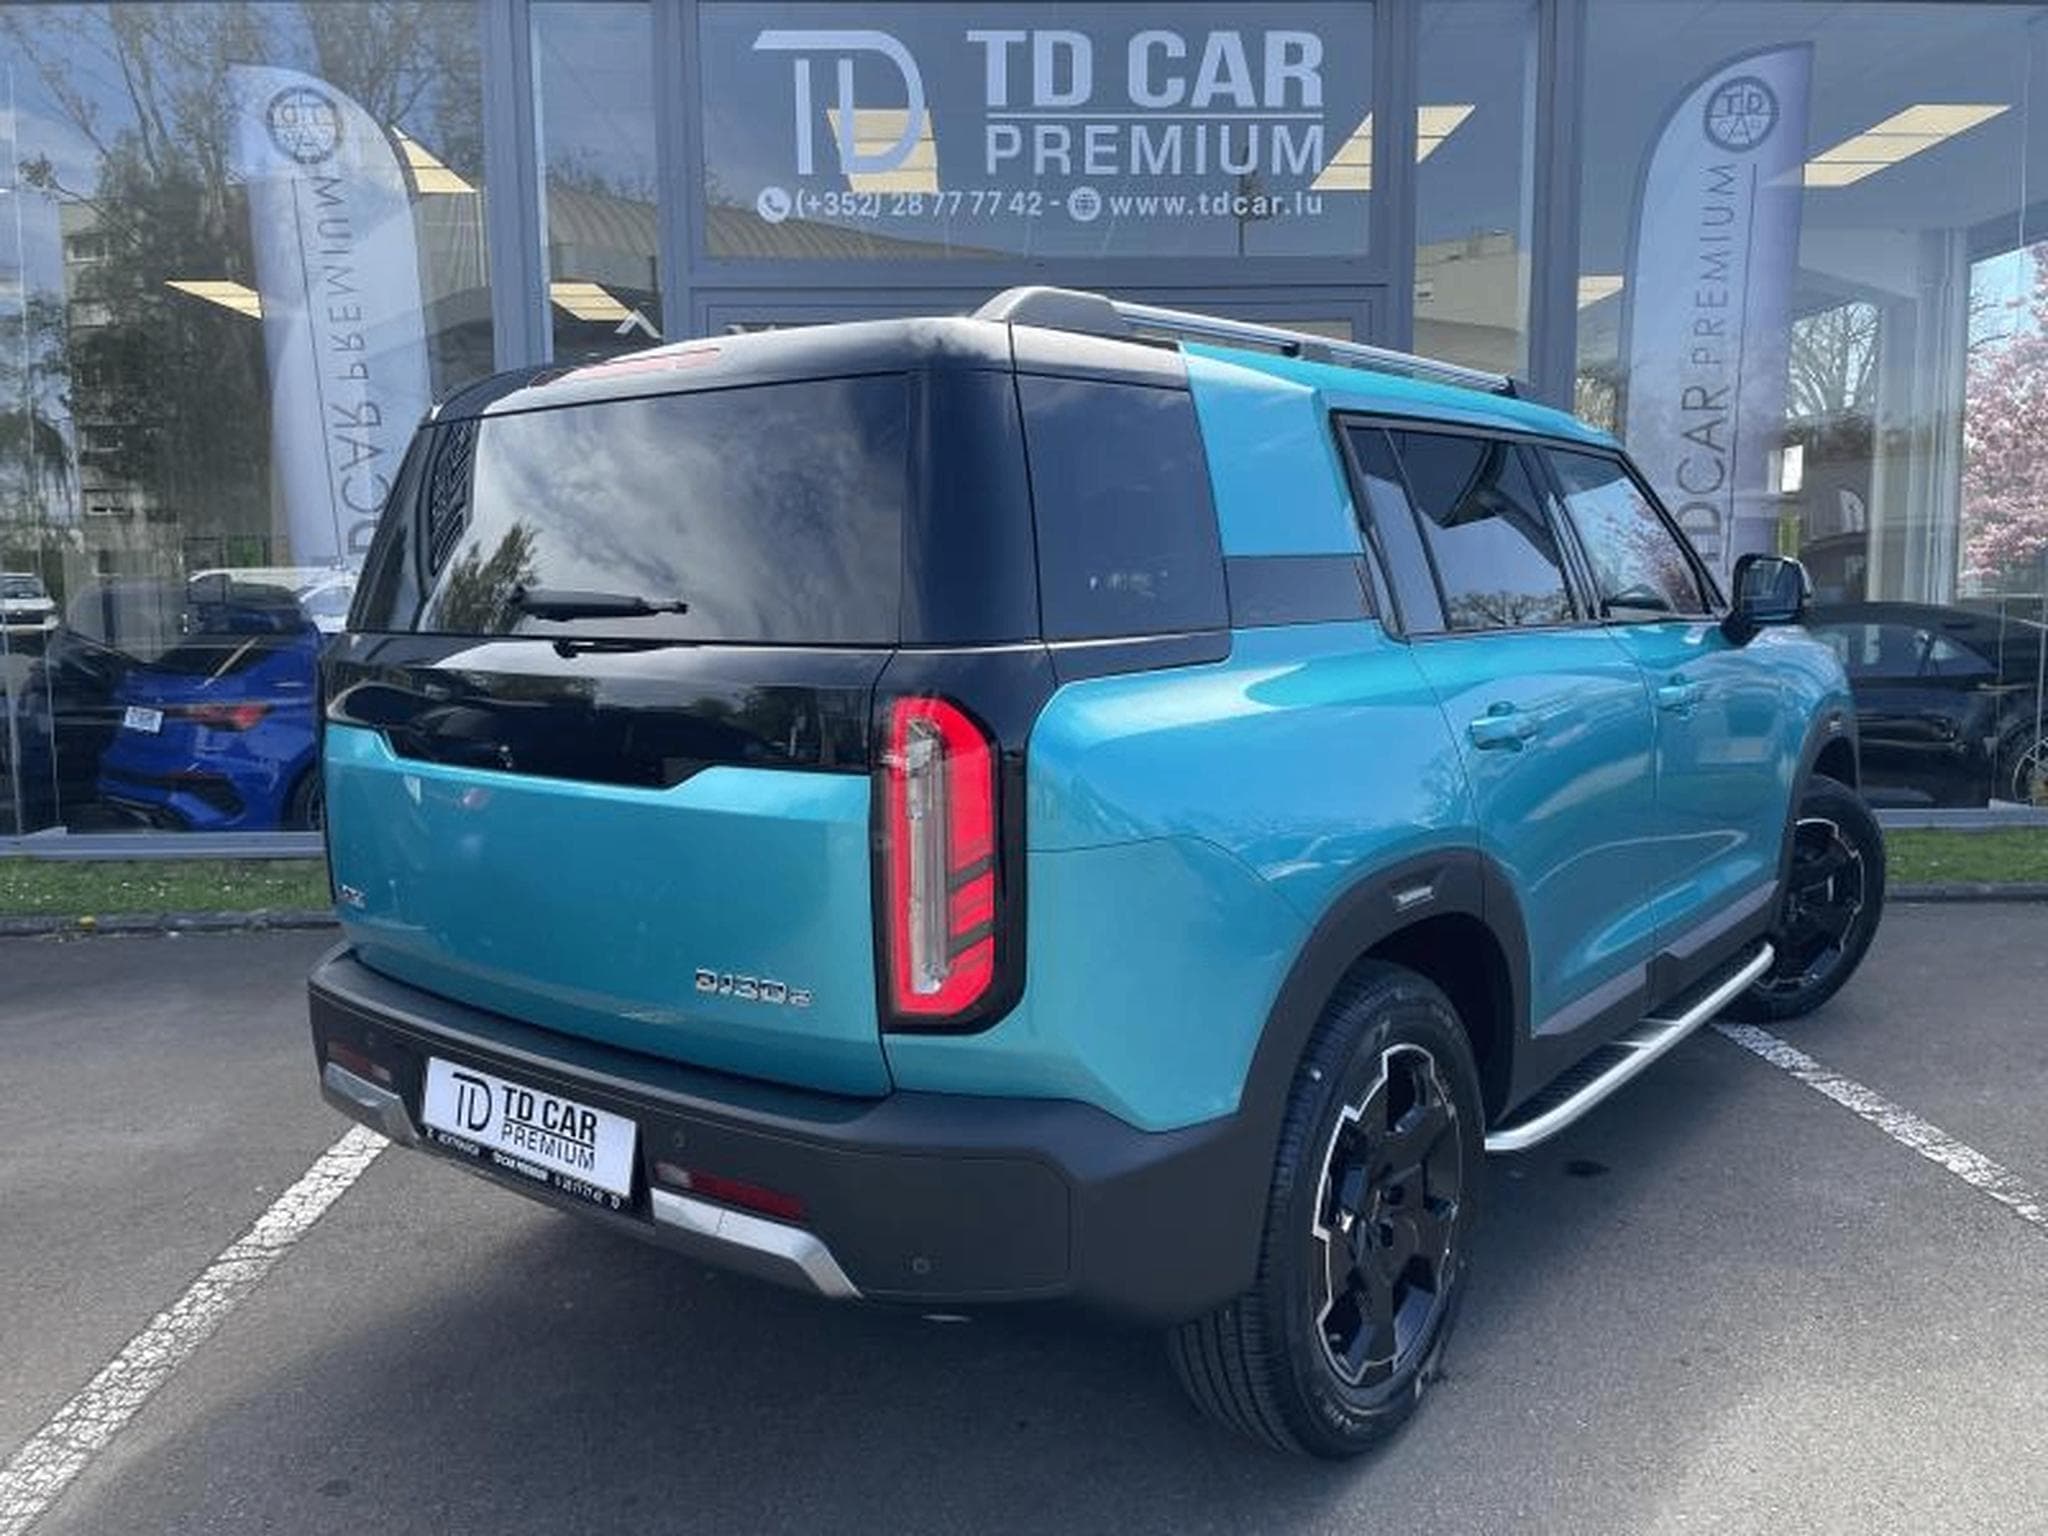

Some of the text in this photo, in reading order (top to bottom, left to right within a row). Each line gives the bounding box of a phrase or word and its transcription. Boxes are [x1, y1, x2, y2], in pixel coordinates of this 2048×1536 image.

[966, 31, 1324, 108] TD CAR
[986, 124, 1324, 175] PREMIUM
[796, 188, 881, 218] (+352)
[890, 191, 923, 216] 28
[933, 190, 962, 216] 77
[971, 190, 1003, 216] 77
[1008, 190, 1044, 216] 42
[1109, 190, 1323, 216] www.tdcar.lu
[1691, 162, 1738, 367] PREMIUM
[501, 1085, 598, 1145] TD CAR
[500, 1123, 597, 1172] PREMIUM
